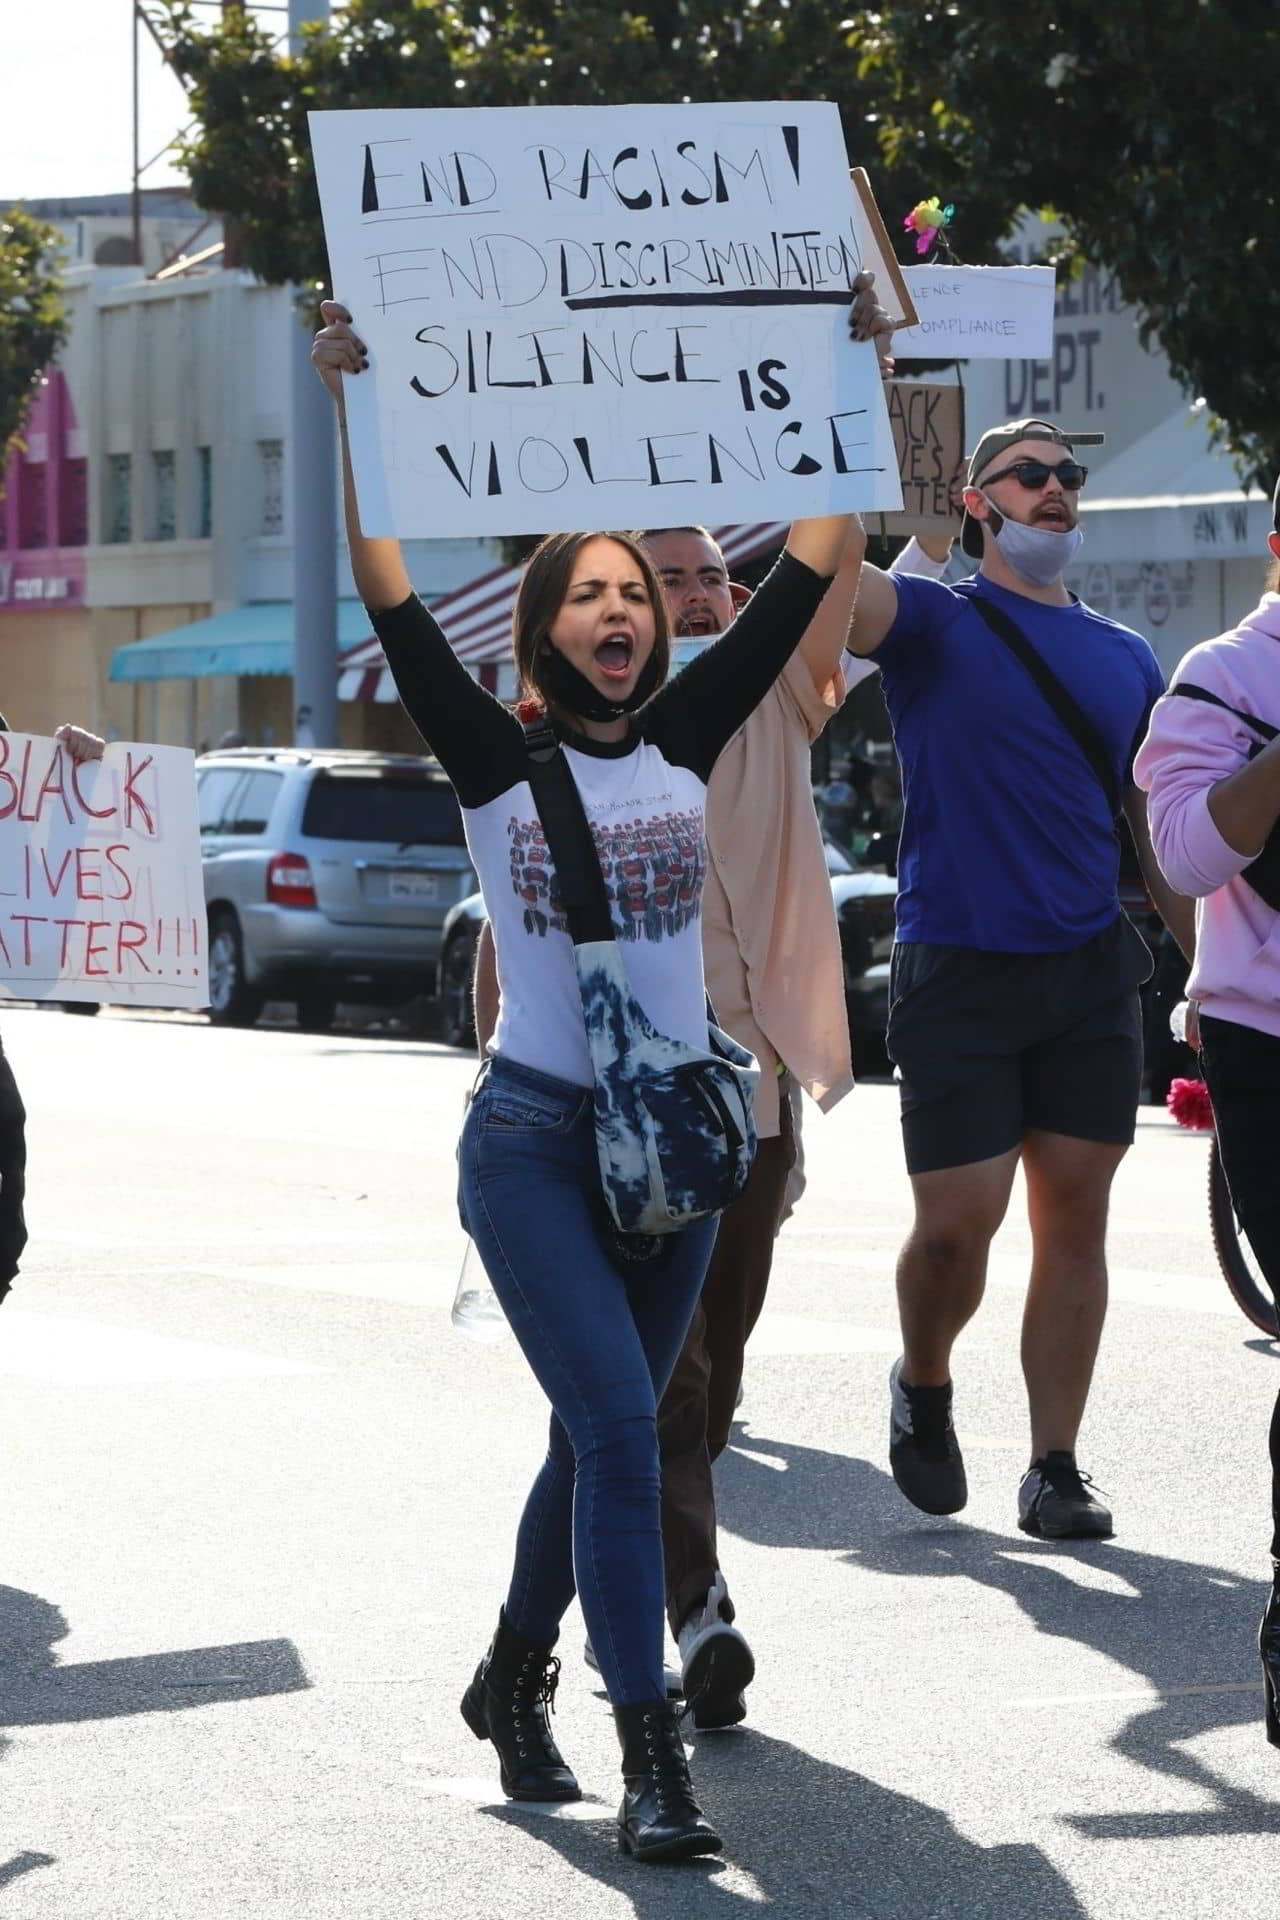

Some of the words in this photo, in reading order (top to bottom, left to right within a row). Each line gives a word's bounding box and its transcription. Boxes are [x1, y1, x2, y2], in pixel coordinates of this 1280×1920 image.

[360, 138, 498, 214] END
[524, 125, 801, 211] RACISM!
[363, 233, 549, 315] END
[545, 218, 864, 297] DISCRIMINATION
[409, 325, 721, 398] SILENCE
[738, 358, 791, 412] IS
[1005, 329, 1105, 416] DEPT.
[436, 409, 887, 498] VIOLENCE
[0, 735, 154, 834] BLACK
